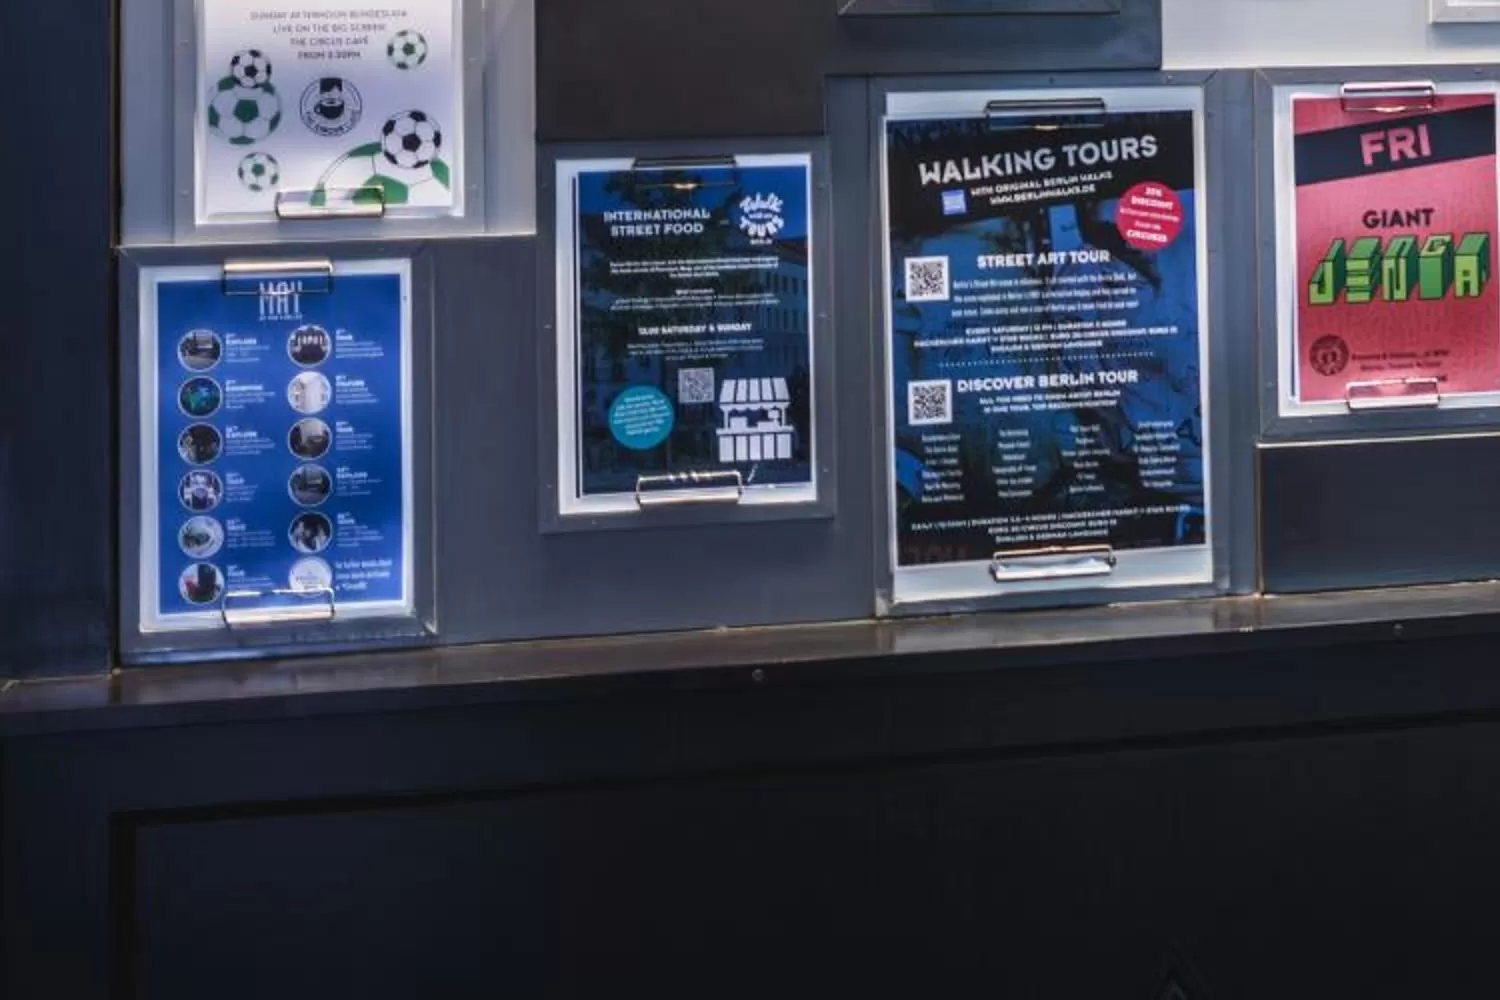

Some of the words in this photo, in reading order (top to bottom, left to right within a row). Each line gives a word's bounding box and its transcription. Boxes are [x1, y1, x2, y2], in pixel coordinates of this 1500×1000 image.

[1360, 124, 1431, 166] FRI
[919, 149, 1056, 185] WALKING
[1062, 135, 1158, 167] TOURS
[603, 208, 711, 222] INTERNATIONAL
[1362, 208, 1435, 229] GIANT
[610, 224, 660, 237] STREET
[663, 223, 703, 234] FOOD
[977, 252, 1033, 269] STREET
[1037, 251, 1066, 266] ART
[1067, 249, 1110, 265] TOUR
[957, 376, 1035, 393] DISCOVER
[1038, 372, 1093, 388] BERLIN
[1097, 370, 1138, 384] TOUR
